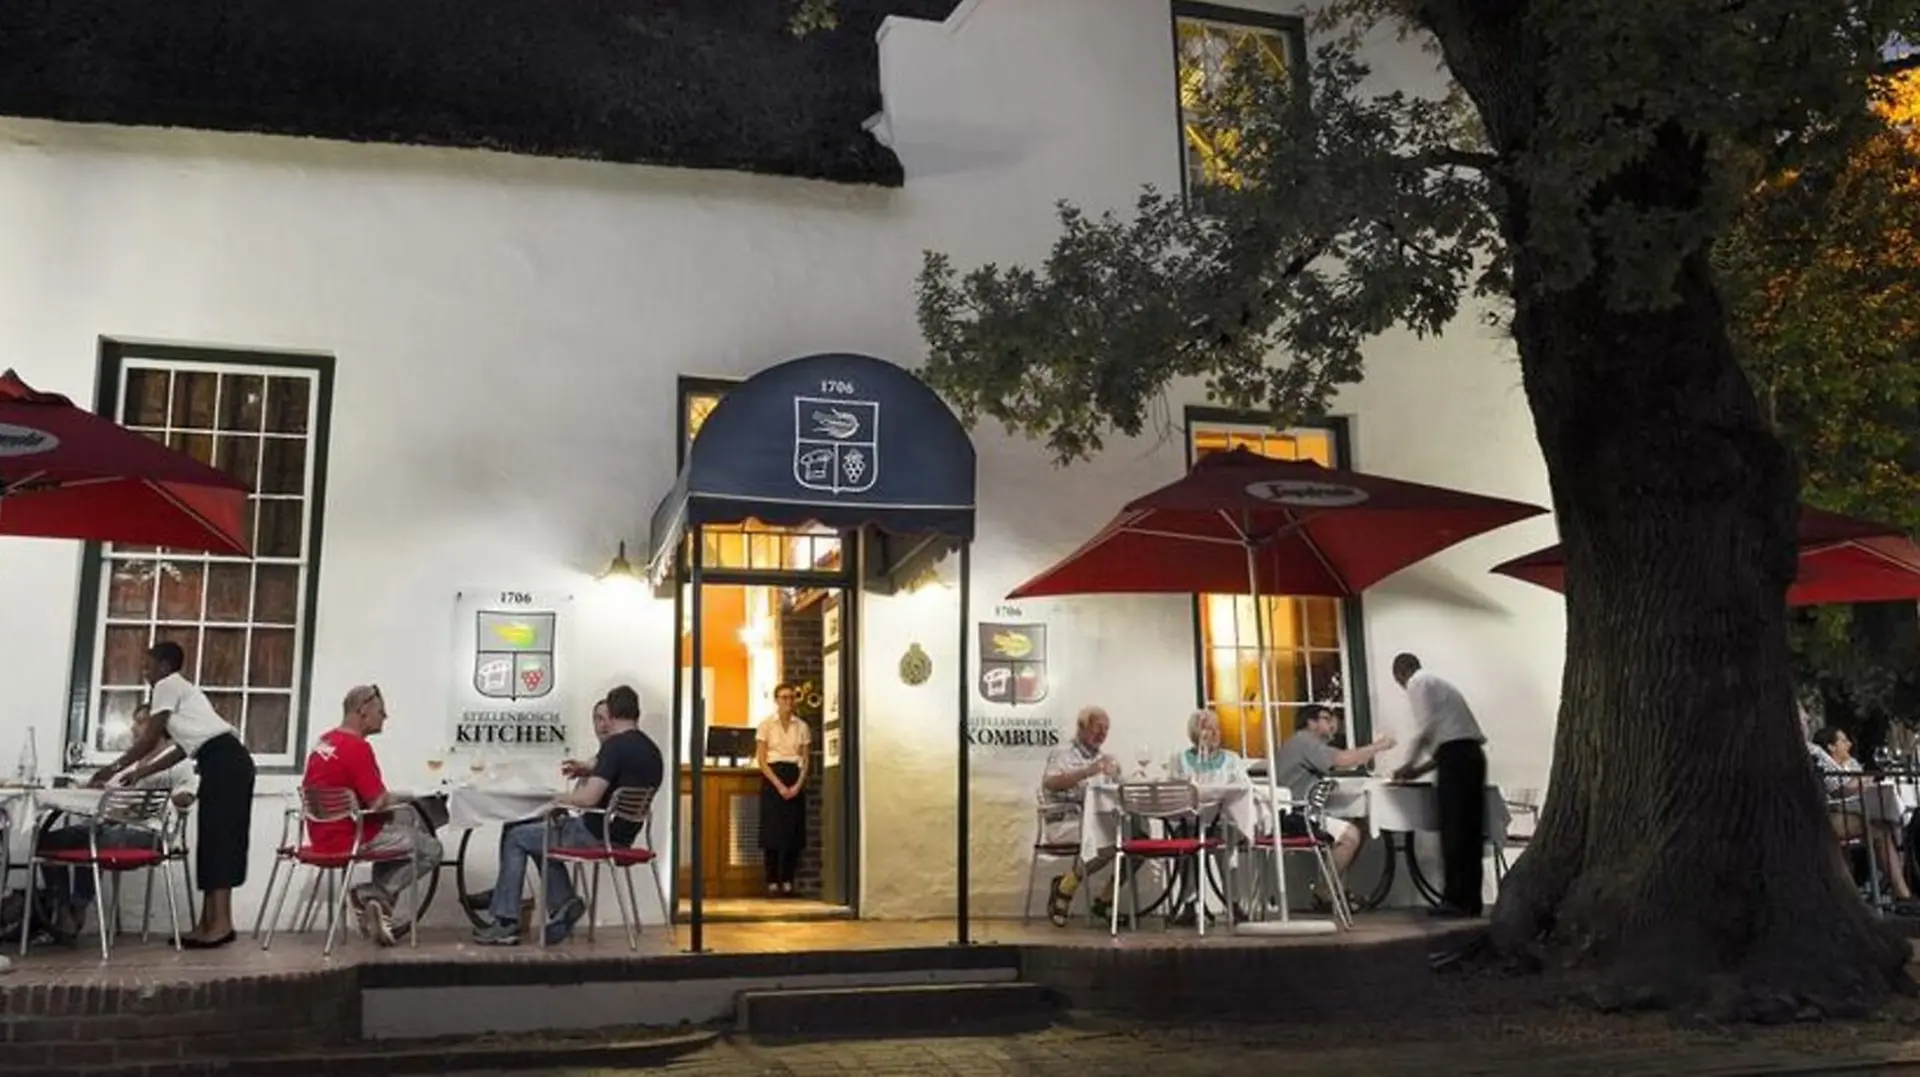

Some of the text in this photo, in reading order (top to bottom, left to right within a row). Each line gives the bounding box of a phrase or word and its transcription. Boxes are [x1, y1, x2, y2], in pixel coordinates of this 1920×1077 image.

[821, 380, 854, 394] 1706
[500, 591, 532, 604] 1706
[456, 724, 568, 743] KITCHEN
